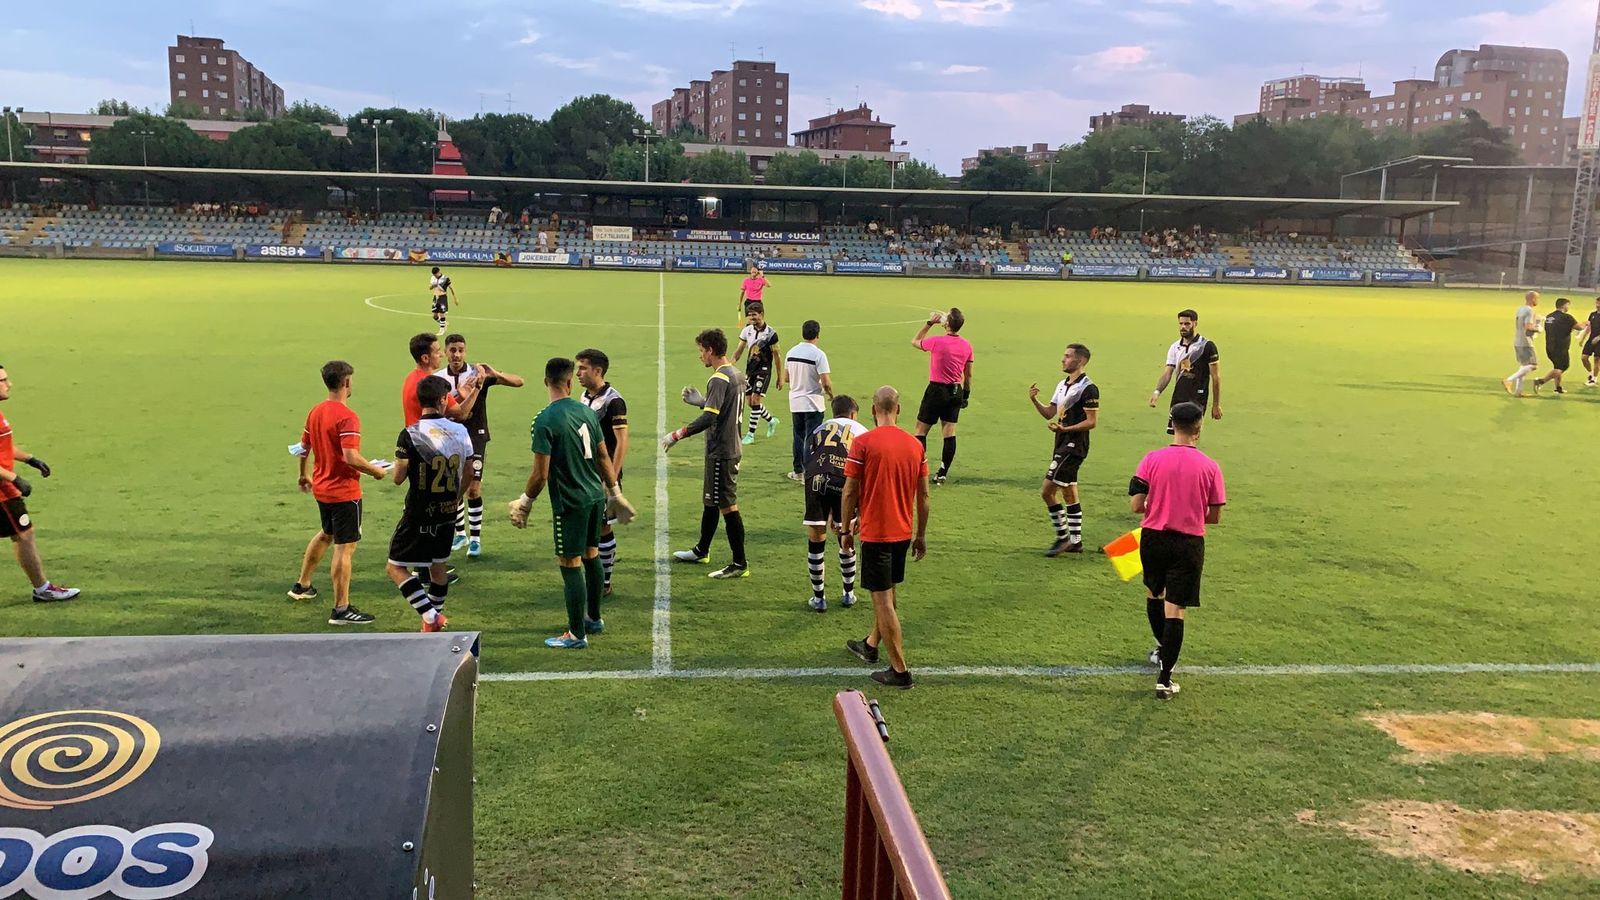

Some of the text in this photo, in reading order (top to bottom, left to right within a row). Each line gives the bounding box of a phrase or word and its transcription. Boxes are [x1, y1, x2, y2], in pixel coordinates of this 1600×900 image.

[260, 246, 296, 256] asisa
[472, 252, 494, 260] ALMA
[521, 254, 557, 262] JOKERBET
[627, 256, 662, 265] Dyscasa
[997, 264, 1022, 272] DeRaza
[824, 421, 855, 451] 24
[578, 423, 592, 459] 1
